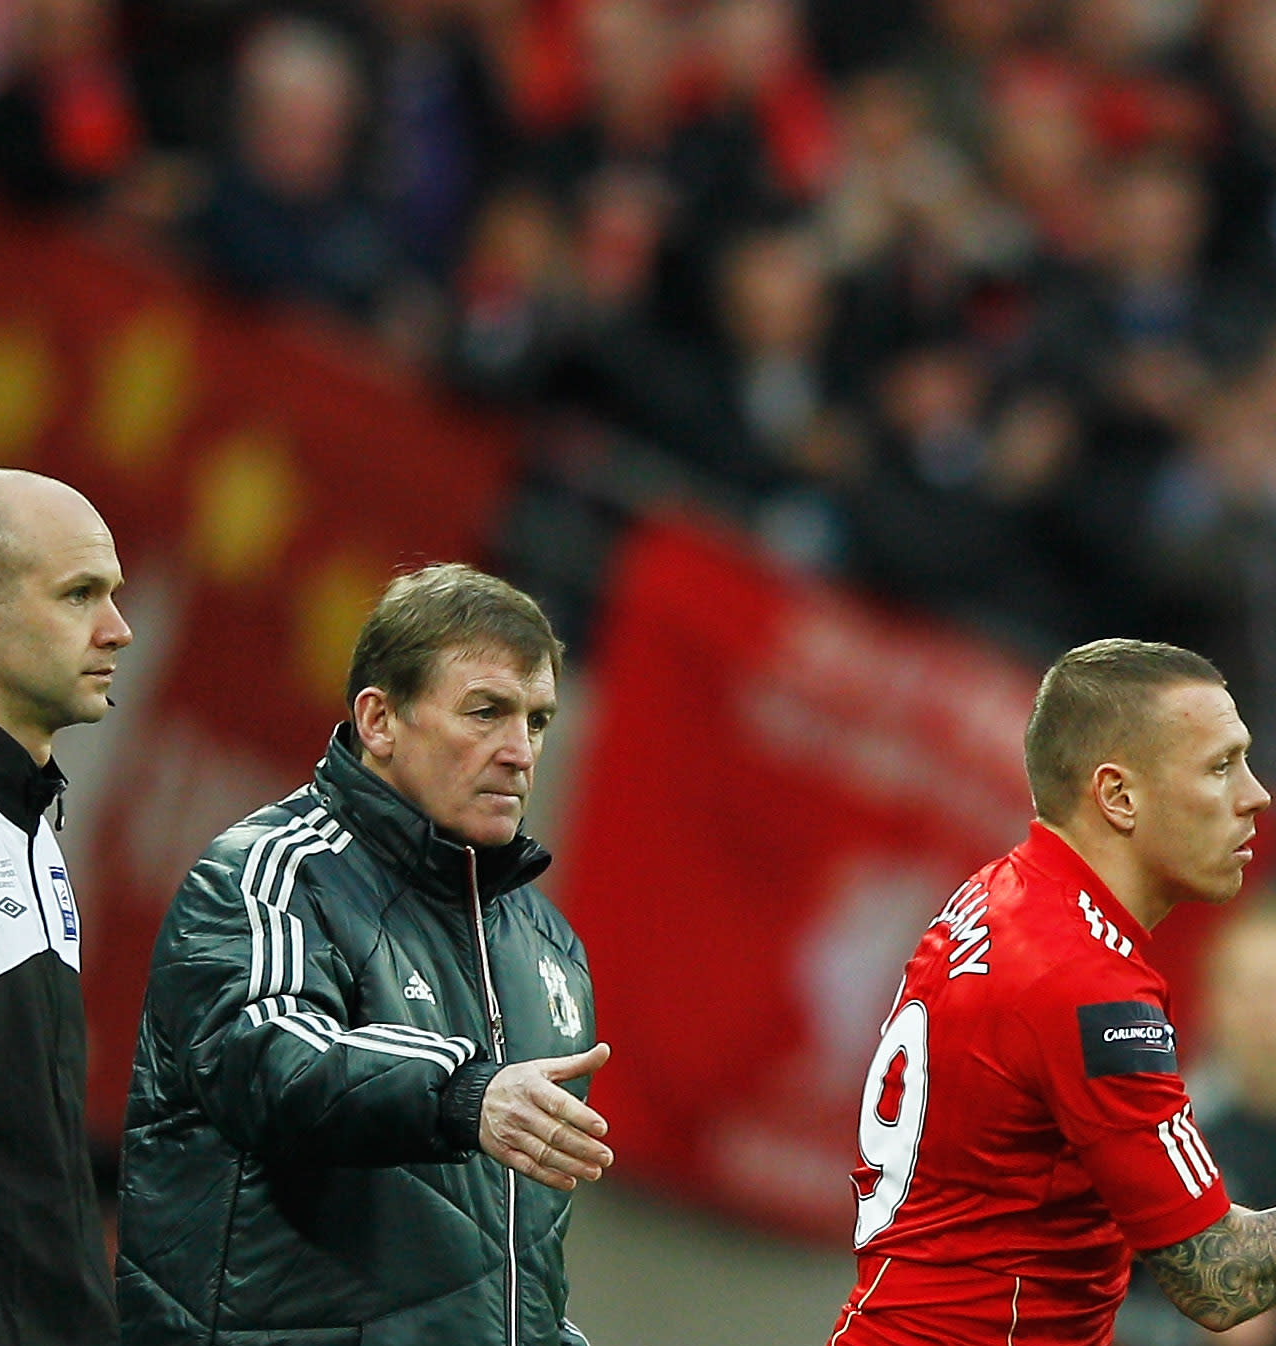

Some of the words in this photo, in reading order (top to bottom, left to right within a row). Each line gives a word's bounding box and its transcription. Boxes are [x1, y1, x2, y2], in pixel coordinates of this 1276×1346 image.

[927, 880, 990, 979] LLAMY
[1103, 1027, 1146, 1042] CARLING
[1146, 1026, 1163, 1039] CUP
[849, 974, 928, 1250] 9
